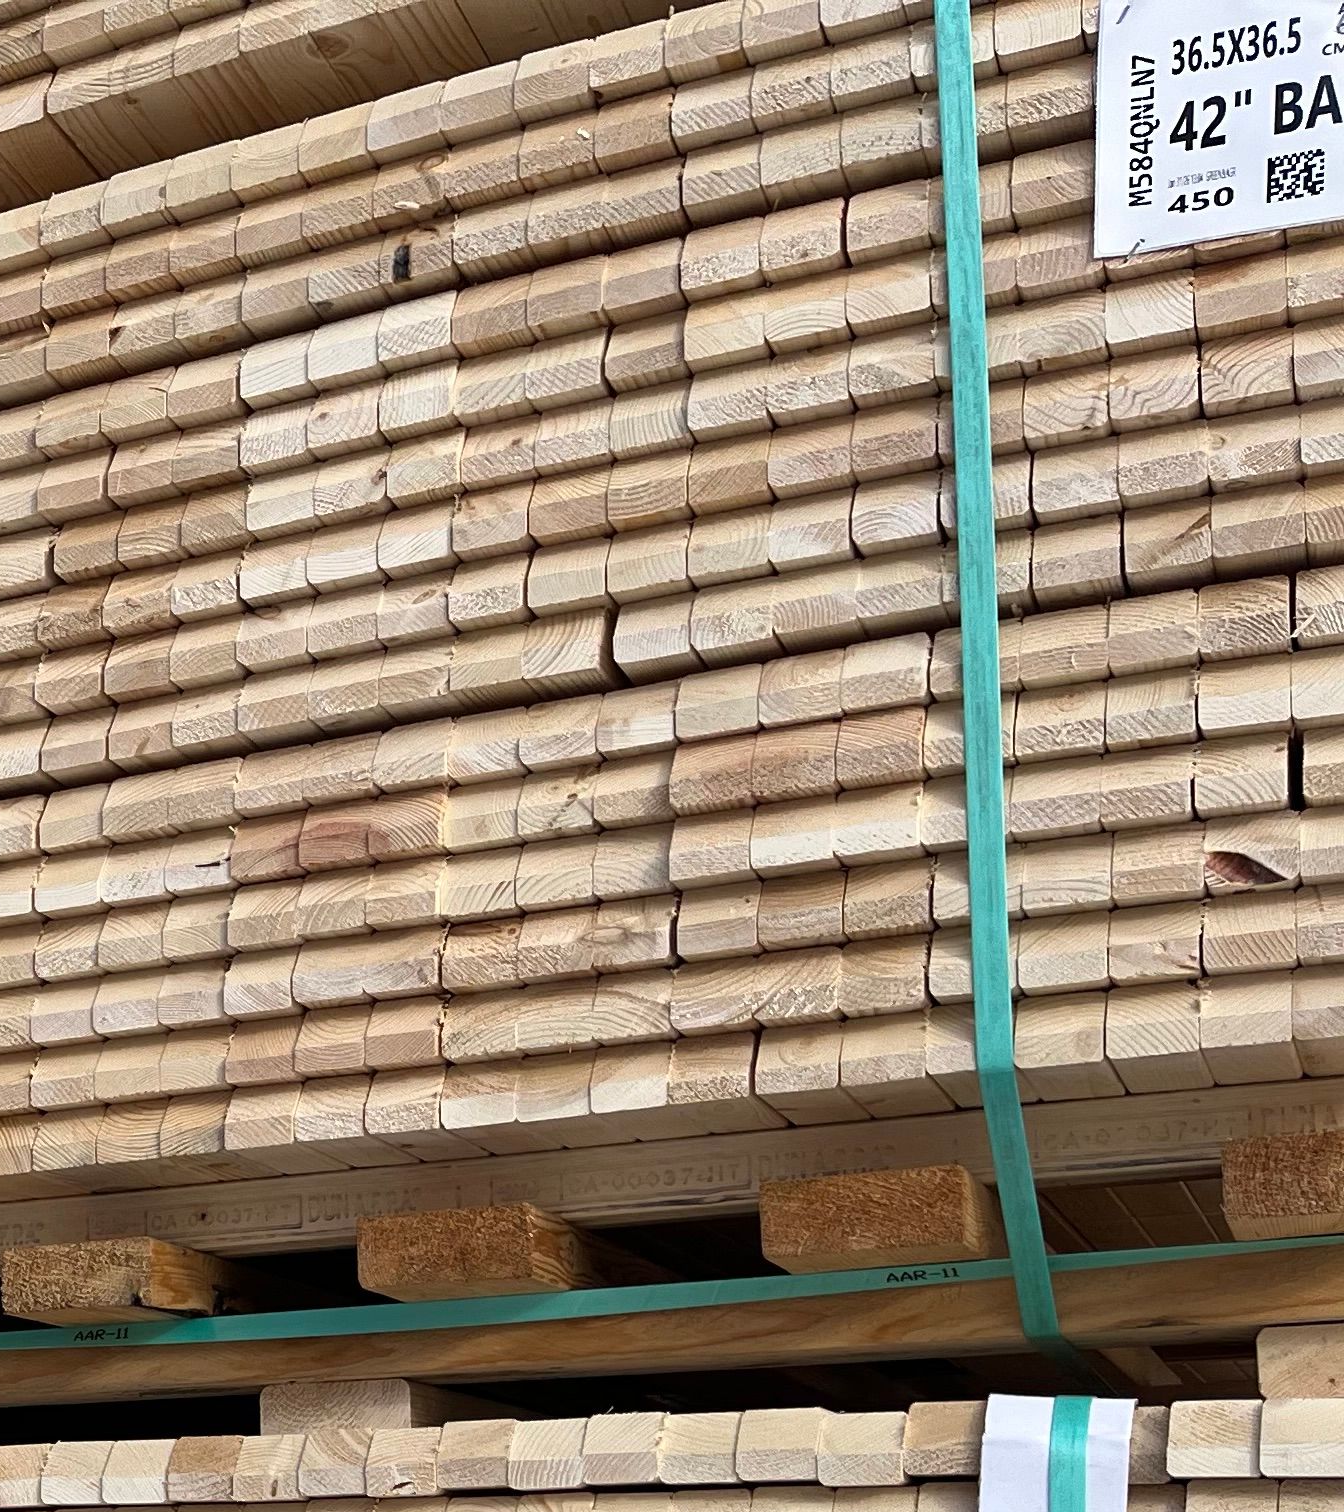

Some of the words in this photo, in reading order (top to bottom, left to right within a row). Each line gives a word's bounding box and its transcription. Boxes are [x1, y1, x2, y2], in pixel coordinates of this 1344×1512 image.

[1171, 17, 1301, 75] 36.5X36.5
[1129, 55, 1160, 207] M584QNLN7
[1169, 89, 1252, 151] 42"
[1167, 187, 1235, 214] 450
